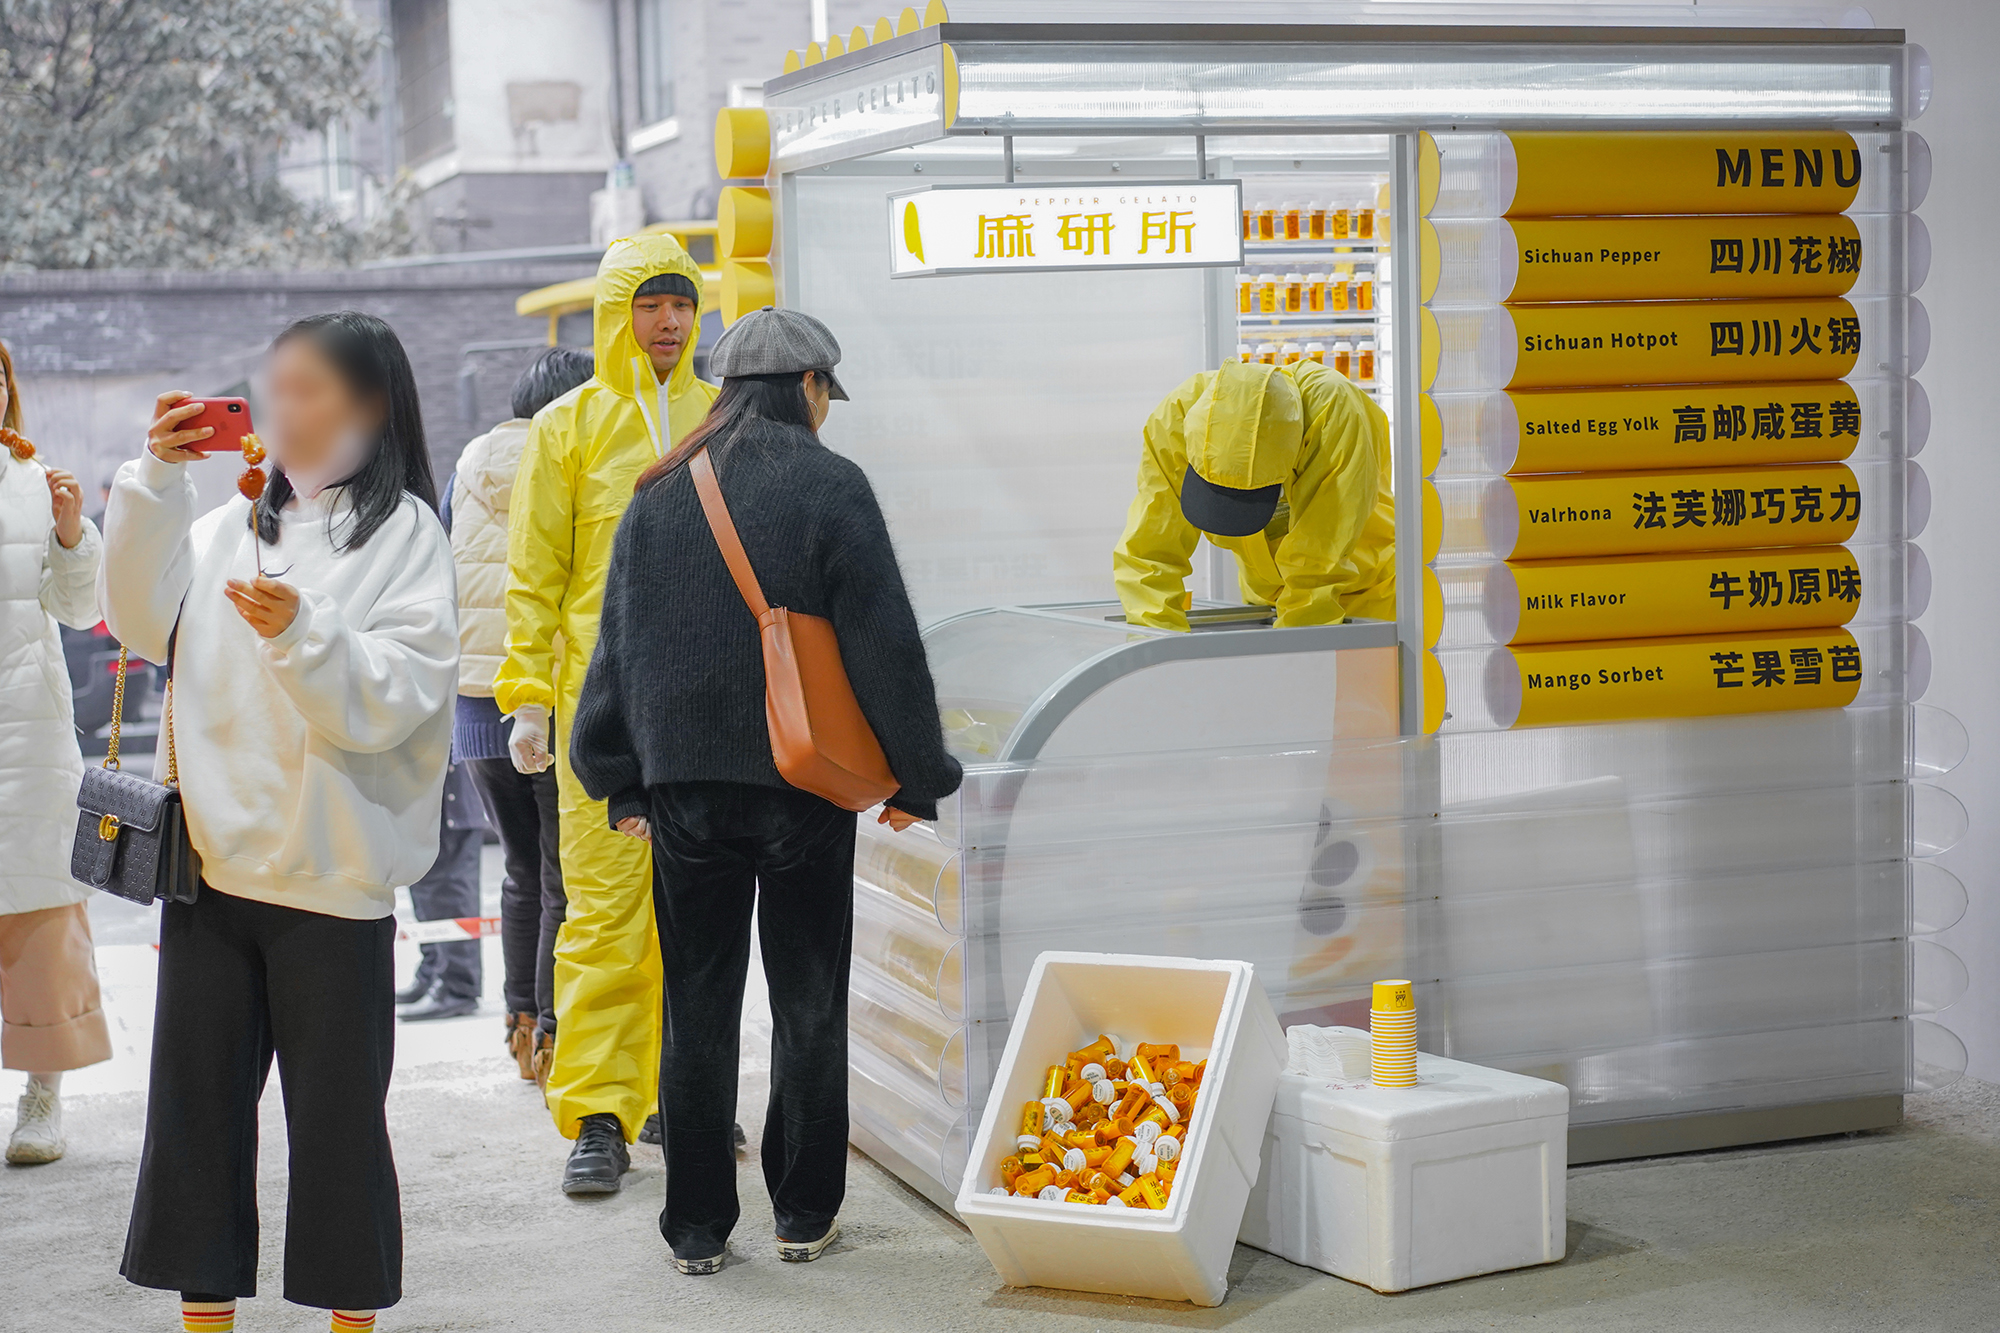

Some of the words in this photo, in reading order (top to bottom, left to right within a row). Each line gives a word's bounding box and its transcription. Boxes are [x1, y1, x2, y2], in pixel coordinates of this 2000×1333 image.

[775, 98, 841, 133] PEPPER
[857, 70, 935, 113] GELATO
[1715, 146, 1862, 188] MENU
[1019, 197, 1100, 206] PEPPER
[1119, 195, 1198, 205] GELATO
[1524, 248, 1594, 264] Sichuan
[1600, 248, 1661, 266] Pepper
[1709, 235, 1862, 275] 四川花椒
[1524, 333, 1603, 352] Sichuan
[1610, 331, 1679, 351] Hotpot
[1709, 316, 1862, 357] 四川火锅
[1525, 419, 1581, 436] Salted
[1587, 419, 1618, 437] Egg
[1622, 416, 1660, 432] Yolk
[1672, 399, 1862, 444] 高邮咸蛋黄
[1528, 506, 1612, 524] Valrhona
[1632, 483, 1862, 530] 法芙娜巧克力
[1526, 594, 1564, 611] Milk
[1570, 590, 1627, 608] Flavor
[1708, 565, 1862, 610] 牛奶原味
[1527, 673, 1591, 691] Mango
[1598, 666, 1664, 685] Sorbet
[1709, 644, 1862, 689] 芒果雪芭
